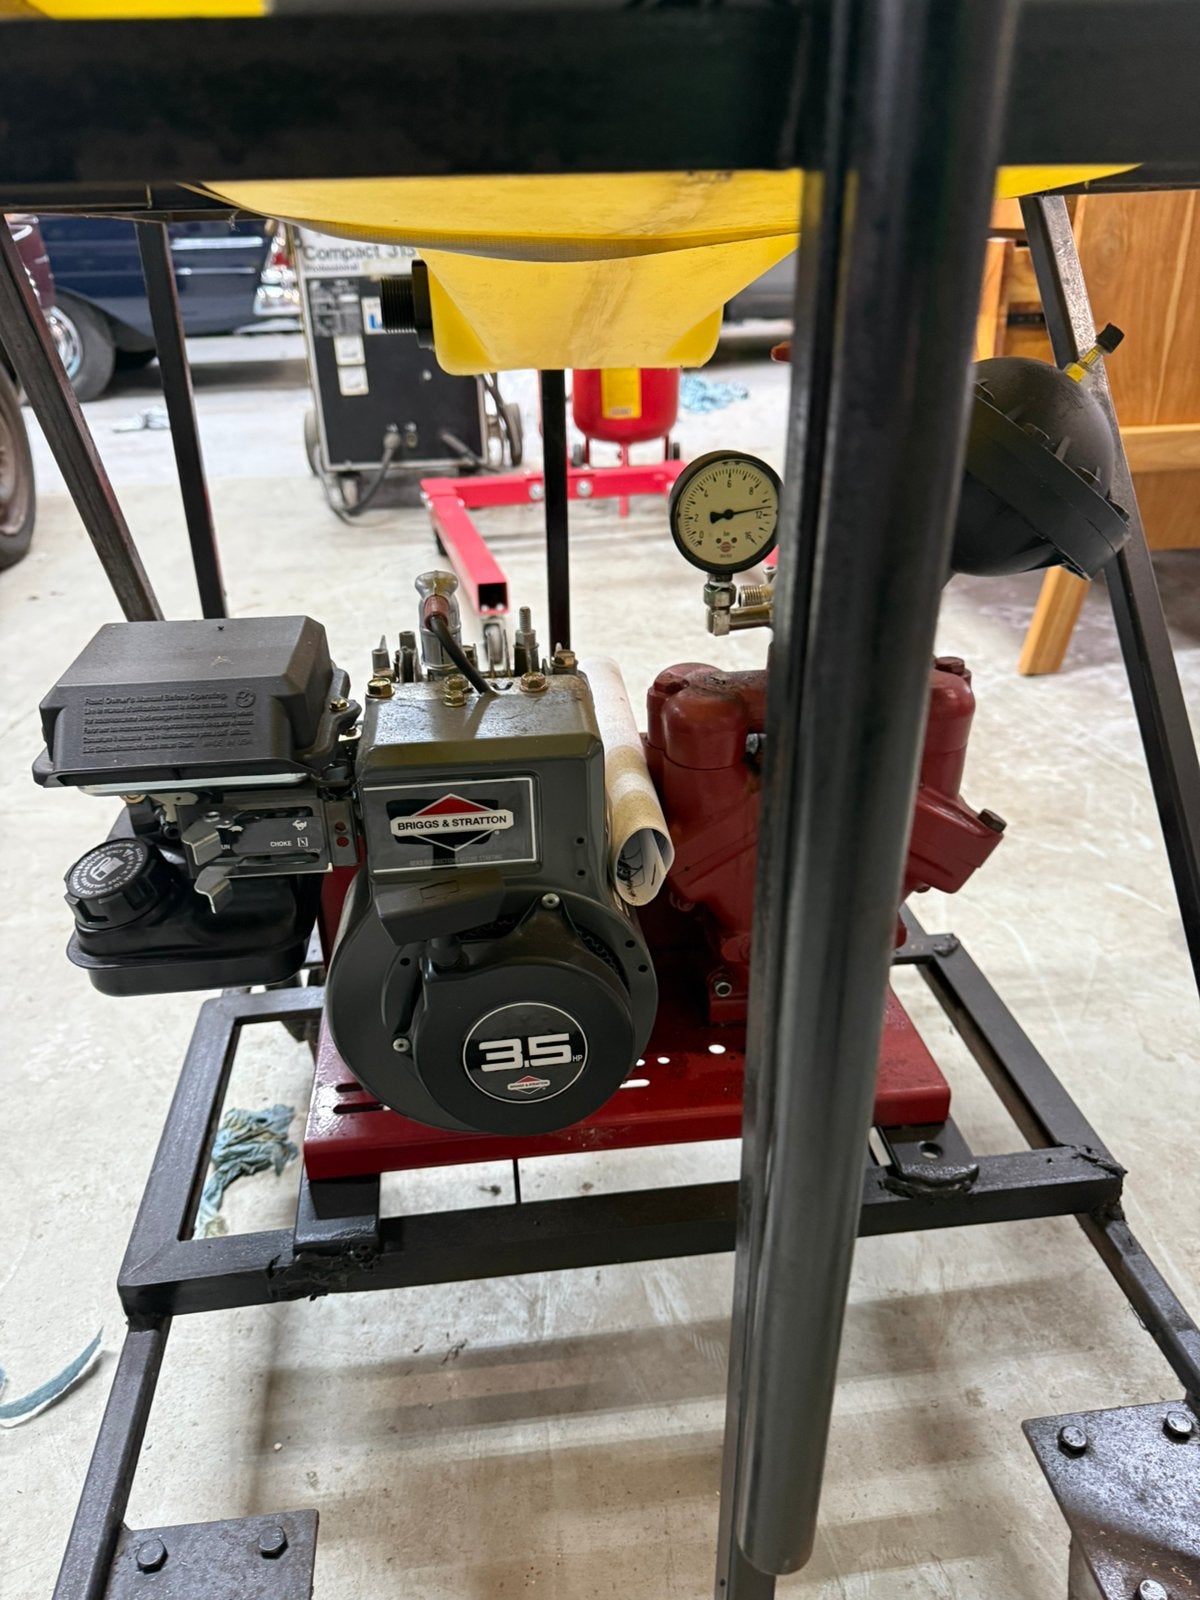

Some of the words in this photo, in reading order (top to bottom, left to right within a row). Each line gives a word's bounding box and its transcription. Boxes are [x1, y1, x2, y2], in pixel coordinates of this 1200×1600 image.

[303, 245, 381, 261] Compact
[727, 480, 732, 488] 6
[749, 486, 754, 495] 8
[694, 514, 699, 522] 2
[755, 511, 763, 519] 12
[398, 820, 439, 830] BRIGGS
[442, 820, 450, 828] &
[452, 816, 507, 826] STRATTON
[479, 1033, 572, 1072] 3.5
